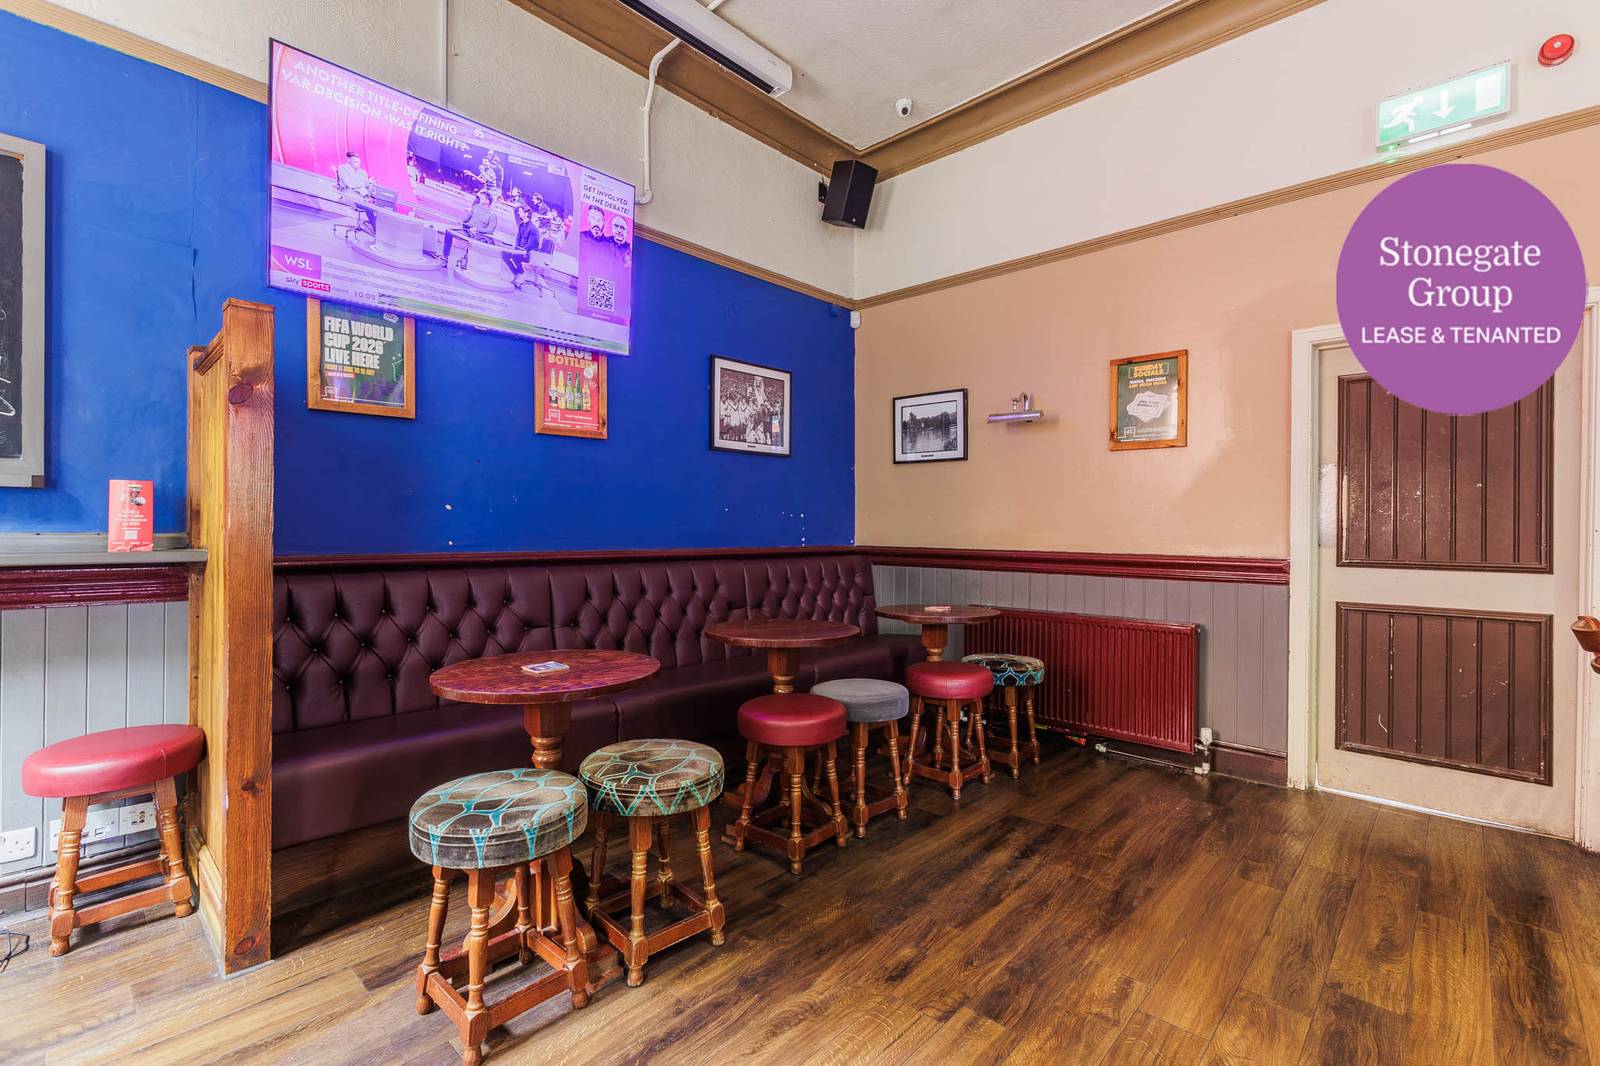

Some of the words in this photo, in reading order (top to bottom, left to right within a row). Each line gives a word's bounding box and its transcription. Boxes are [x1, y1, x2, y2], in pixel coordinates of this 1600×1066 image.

[294, 62, 366, 96] ANOTHER
[282, 69, 312, 91] VAR
[314, 86, 381, 117] DECISION
[583, 184, 596, 194] GET
[597, 190, 628, 206] INVOLVED
[592, 196, 604, 205] THE
[285, 254, 314, 271] WSL
[285, 276, 300, 287] sky
[302, 280, 330, 292] sports
[324, 316, 350, 334] FIFA
[350, 320, 394, 342] WORLD
[324, 331, 350, 350] CUP
[324, 347, 351, 365] LIVE
[351, 351, 381, 370] HERE
[548, 344, 593, 360] VALUE
[1133, 368, 1164, 378] SOCIALS
[1134, 363, 1163, 371] SUNDAY
